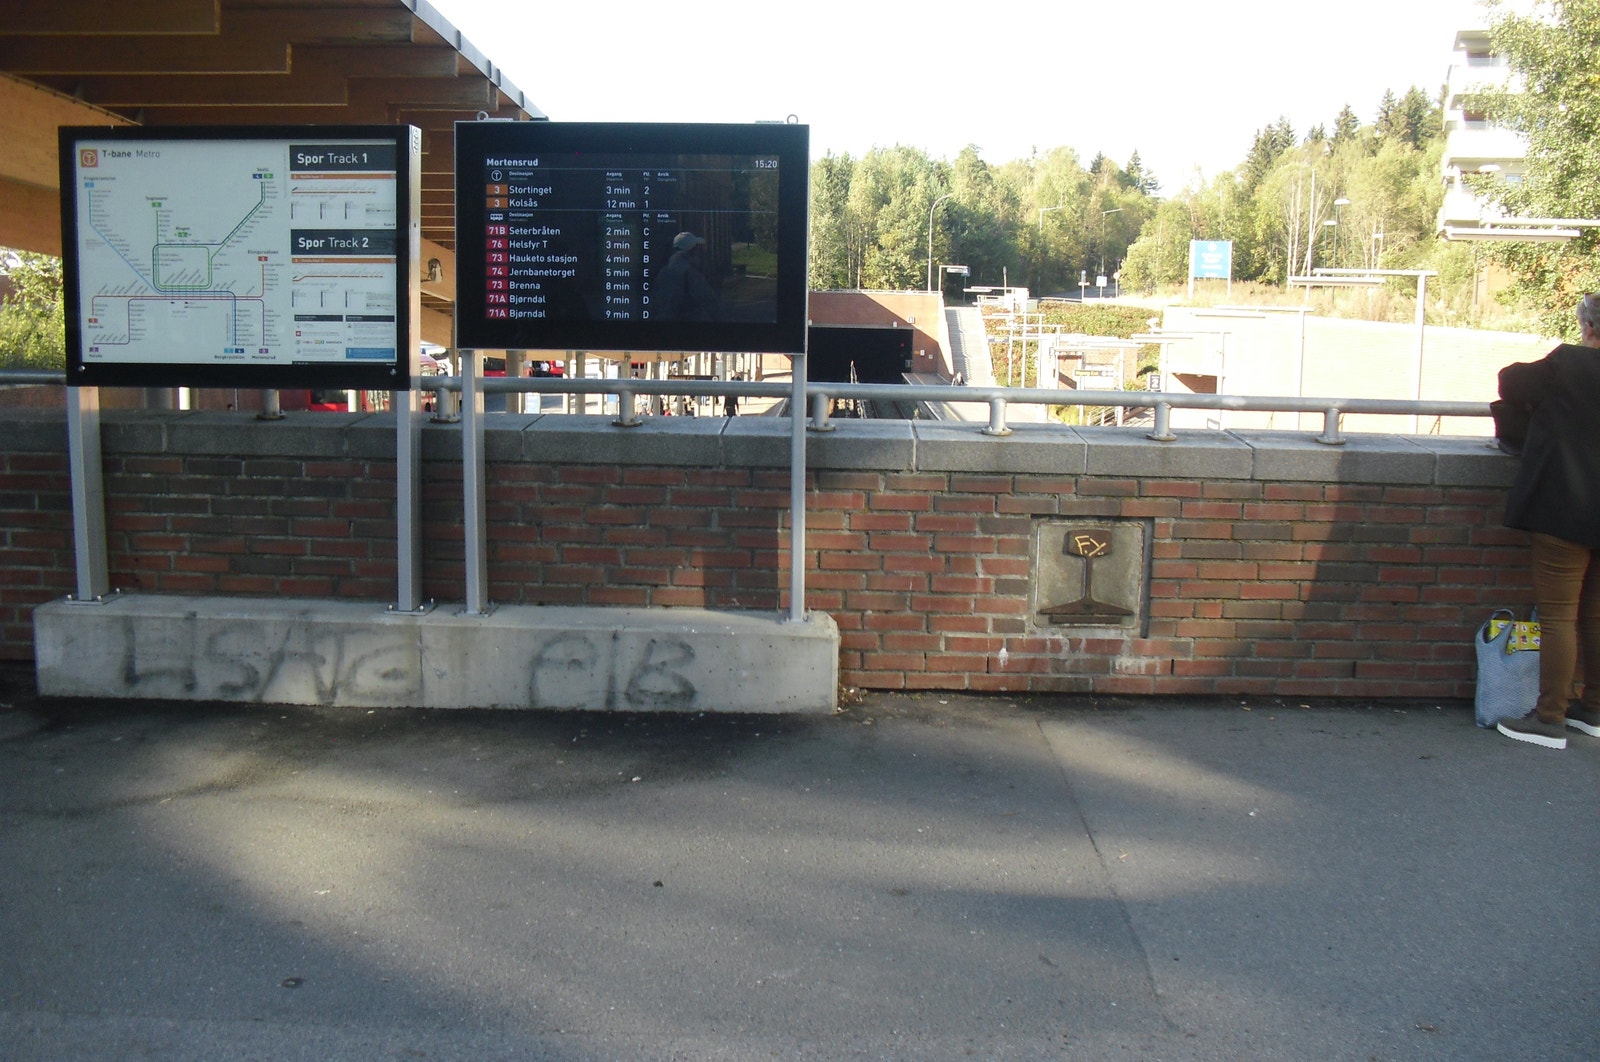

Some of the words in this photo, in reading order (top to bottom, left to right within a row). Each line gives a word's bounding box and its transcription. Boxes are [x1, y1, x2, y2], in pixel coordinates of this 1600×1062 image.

[102, 150, 132, 158] T-bane
[136, 150, 161, 158] Metro
[297, 153, 324, 166] Spor
[327, 152, 358, 164] Track
[362, 152, 368, 164] 1
[486, 158, 539, 167] Mortensrud
[755, 160, 777, 168] 15:20
[494, 184, 500, 194] 3
[509, 185, 552, 196] Stortinget
[606, 185, 612, 195] 3
[614, 186, 630, 195] min
[644, 186, 650, 195] 2
[494, 198, 500, 208] 3
[509, 198, 538, 208] Kolsås
[607, 200, 617, 209] 12
[619, 200, 636, 209] min
[645, 200, 649, 209] 1
[489, 226, 506, 235] 71B
[509, 226, 561, 235] Seterbråten
[606, 227, 612, 236] 2
[613, 227, 630, 236] min
[643, 227, 650, 236] C
[298, 237, 325, 250] Spor
[328, 237, 359, 248] Track
[362, 237, 369, 248] 2
[492, 240, 503, 249] 76
[509, 240, 540, 250] Helsfyr
[542, 240, 548, 249] T
[606, 240, 612, 249] 3
[613, 241, 630, 249] min
[643, 241, 650, 250] E
[492, 253, 503, 263] 73
[509, 254, 545, 263] Hauketo
[546, 254, 578, 265] stasjon
[606, 254, 612, 263] 4
[613, 254, 630, 263] min
[643, 254, 650, 264] B
[492, 267, 503, 276] 74
[509, 267, 576, 279] Jernbanetorget
[606, 268, 612, 277] 5
[613, 268, 630, 277] min
[643, 268, 650, 277] E
[492, 280, 503, 289] 73
[509, 281, 541, 290] Brenna
[605, 281, 612, 290] 8
[613, 282, 630, 290] min
[642, 282, 650, 291] C
[489, 294, 506, 303] 71A
[509, 294, 546, 305] Bjørndal
[605, 295, 612, 304] 9
[613, 295, 630, 304] min
[642, 295, 650, 305] D
[489, 308, 506, 318] 71A
[509, 308, 546, 319] Bjørndal
[605, 309, 612, 318] 9
[613, 310, 630, 319] min
[642, 310, 650, 319] D
[1151, 380, 1159, 389] 2
